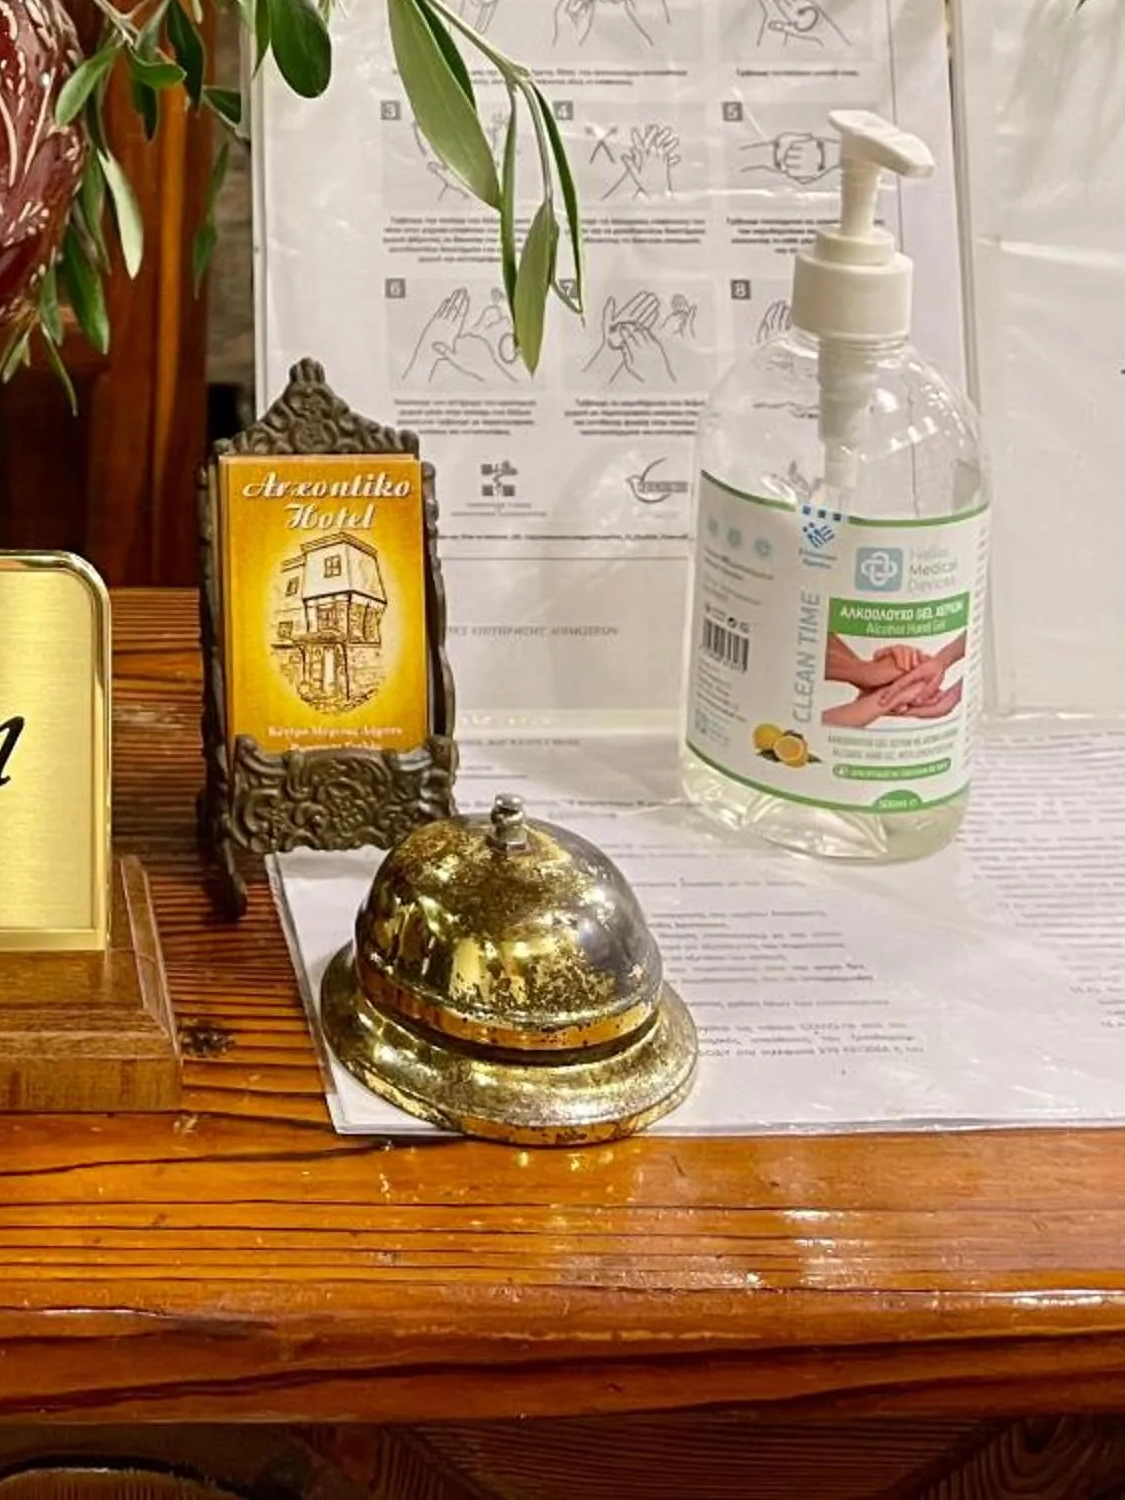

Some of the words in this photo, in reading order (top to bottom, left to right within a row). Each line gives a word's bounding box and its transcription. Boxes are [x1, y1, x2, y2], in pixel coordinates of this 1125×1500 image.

[283, 502, 376, 530] Hotel
[798, 590, 821, 646] TIME
[792, 650, 817, 724] CLEAN
